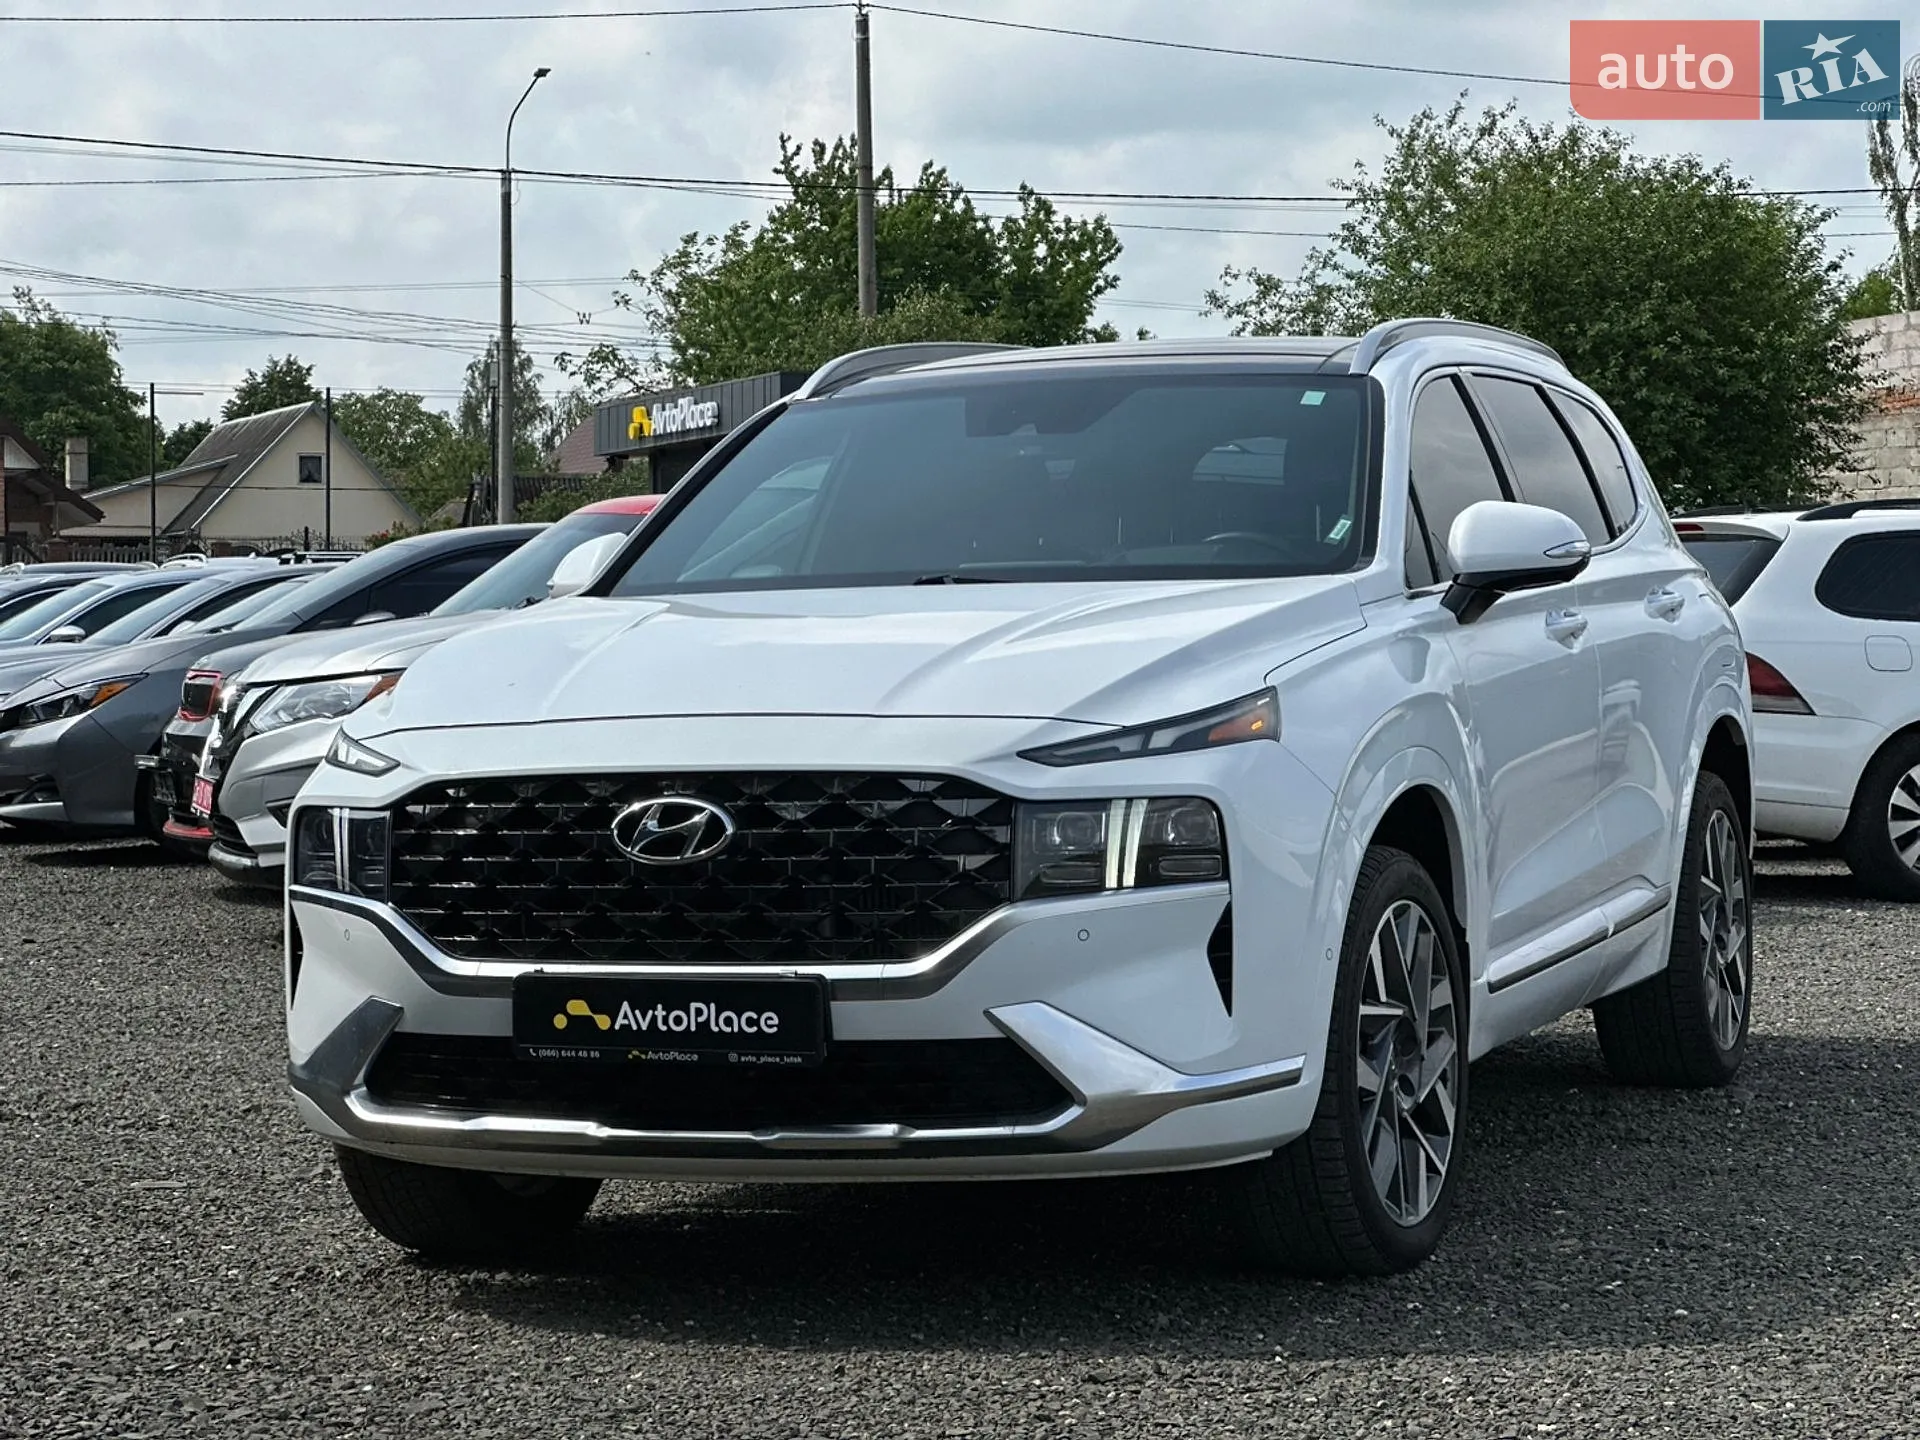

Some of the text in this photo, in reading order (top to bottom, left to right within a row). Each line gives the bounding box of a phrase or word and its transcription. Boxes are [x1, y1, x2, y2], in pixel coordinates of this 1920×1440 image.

[651, 397, 718, 436] AvtoPlace
[615, 1001, 779, 1034] AvtoPlace
[647, 1050, 698, 1061] AvtoPlace
